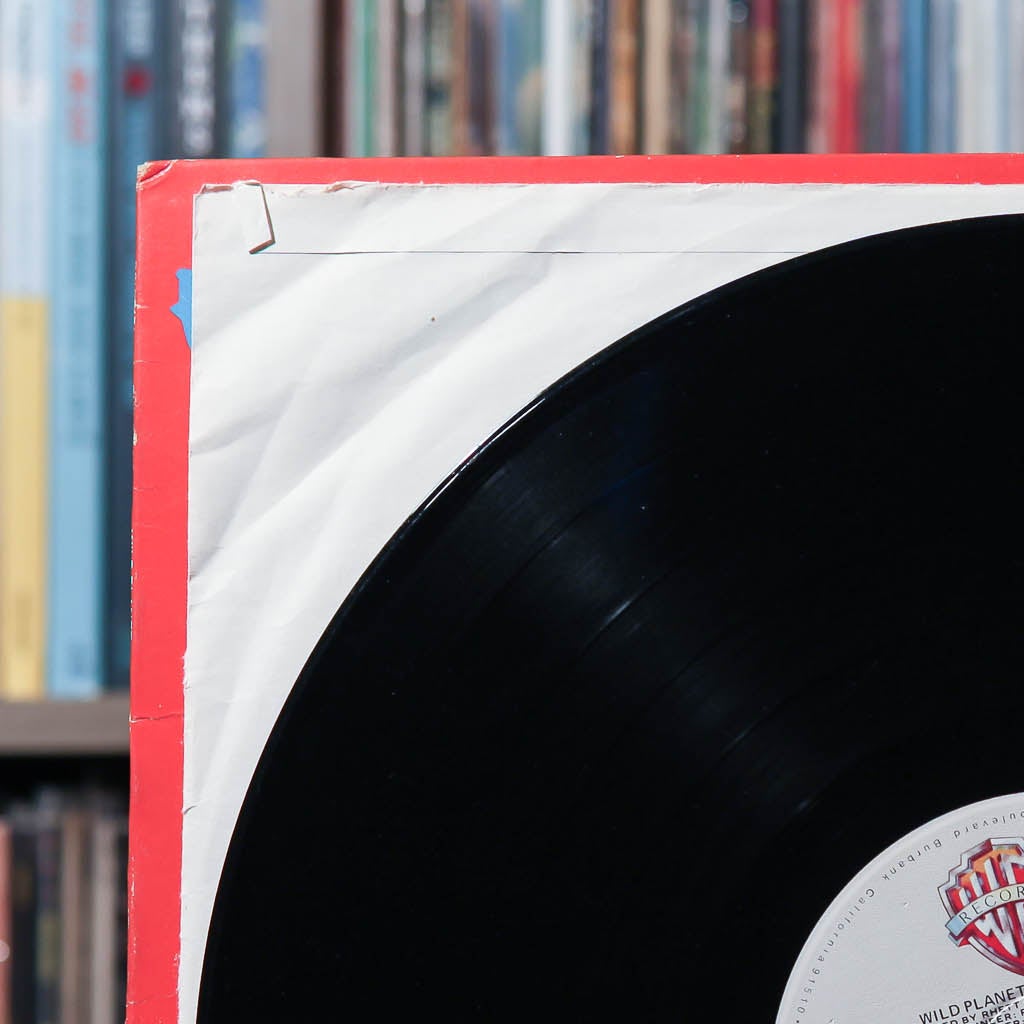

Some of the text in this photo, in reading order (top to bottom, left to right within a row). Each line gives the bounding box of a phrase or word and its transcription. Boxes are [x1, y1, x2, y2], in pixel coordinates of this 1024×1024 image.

[918, 1003, 963, 1024] WILD
[959, 1012, 979, 1024] BY
[980, 1000, 1022, 1019] RHETT
